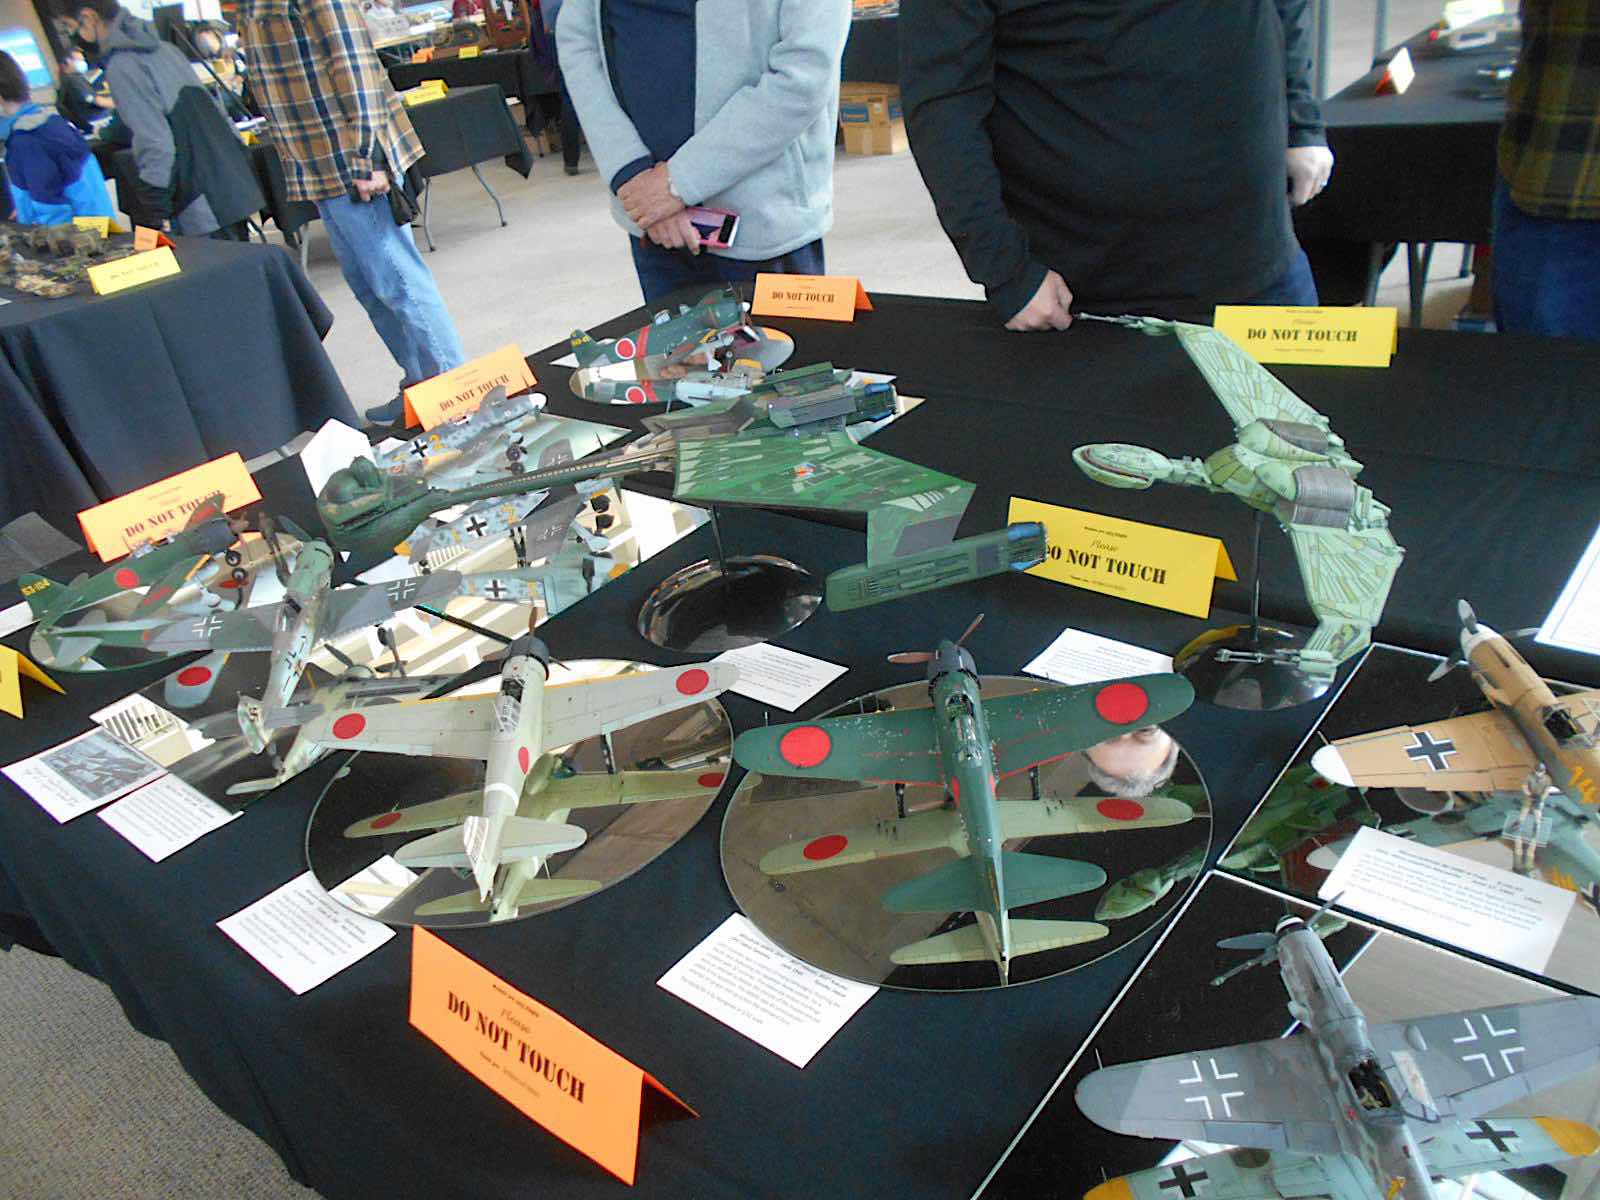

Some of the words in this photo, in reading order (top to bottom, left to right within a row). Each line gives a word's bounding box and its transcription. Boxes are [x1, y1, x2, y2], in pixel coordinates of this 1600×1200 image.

[772, 291, 784, 300] DO
[787, 291, 803, 301] NOT
[805, 292, 835, 303] TOUCH
[1248, 328, 1267, 340] DO
[1270, 329, 1301, 341] NOT
[1305, 329, 1358, 342] TOUCH
[440, 400, 455, 412] DO
[456, 390, 476, 404] NOT
[126, 523, 145, 537] DO
[148, 510, 176, 527] NOT
[1047, 545, 1062, 561] O
[1067, 549, 1101, 569] NOT
[1106, 557, 1167, 584] TOUCH
[448, 991, 471, 1022] DO
[475, 1010, 512, 1052] NOT
[517, 1039, 586, 1103] TOUCH
